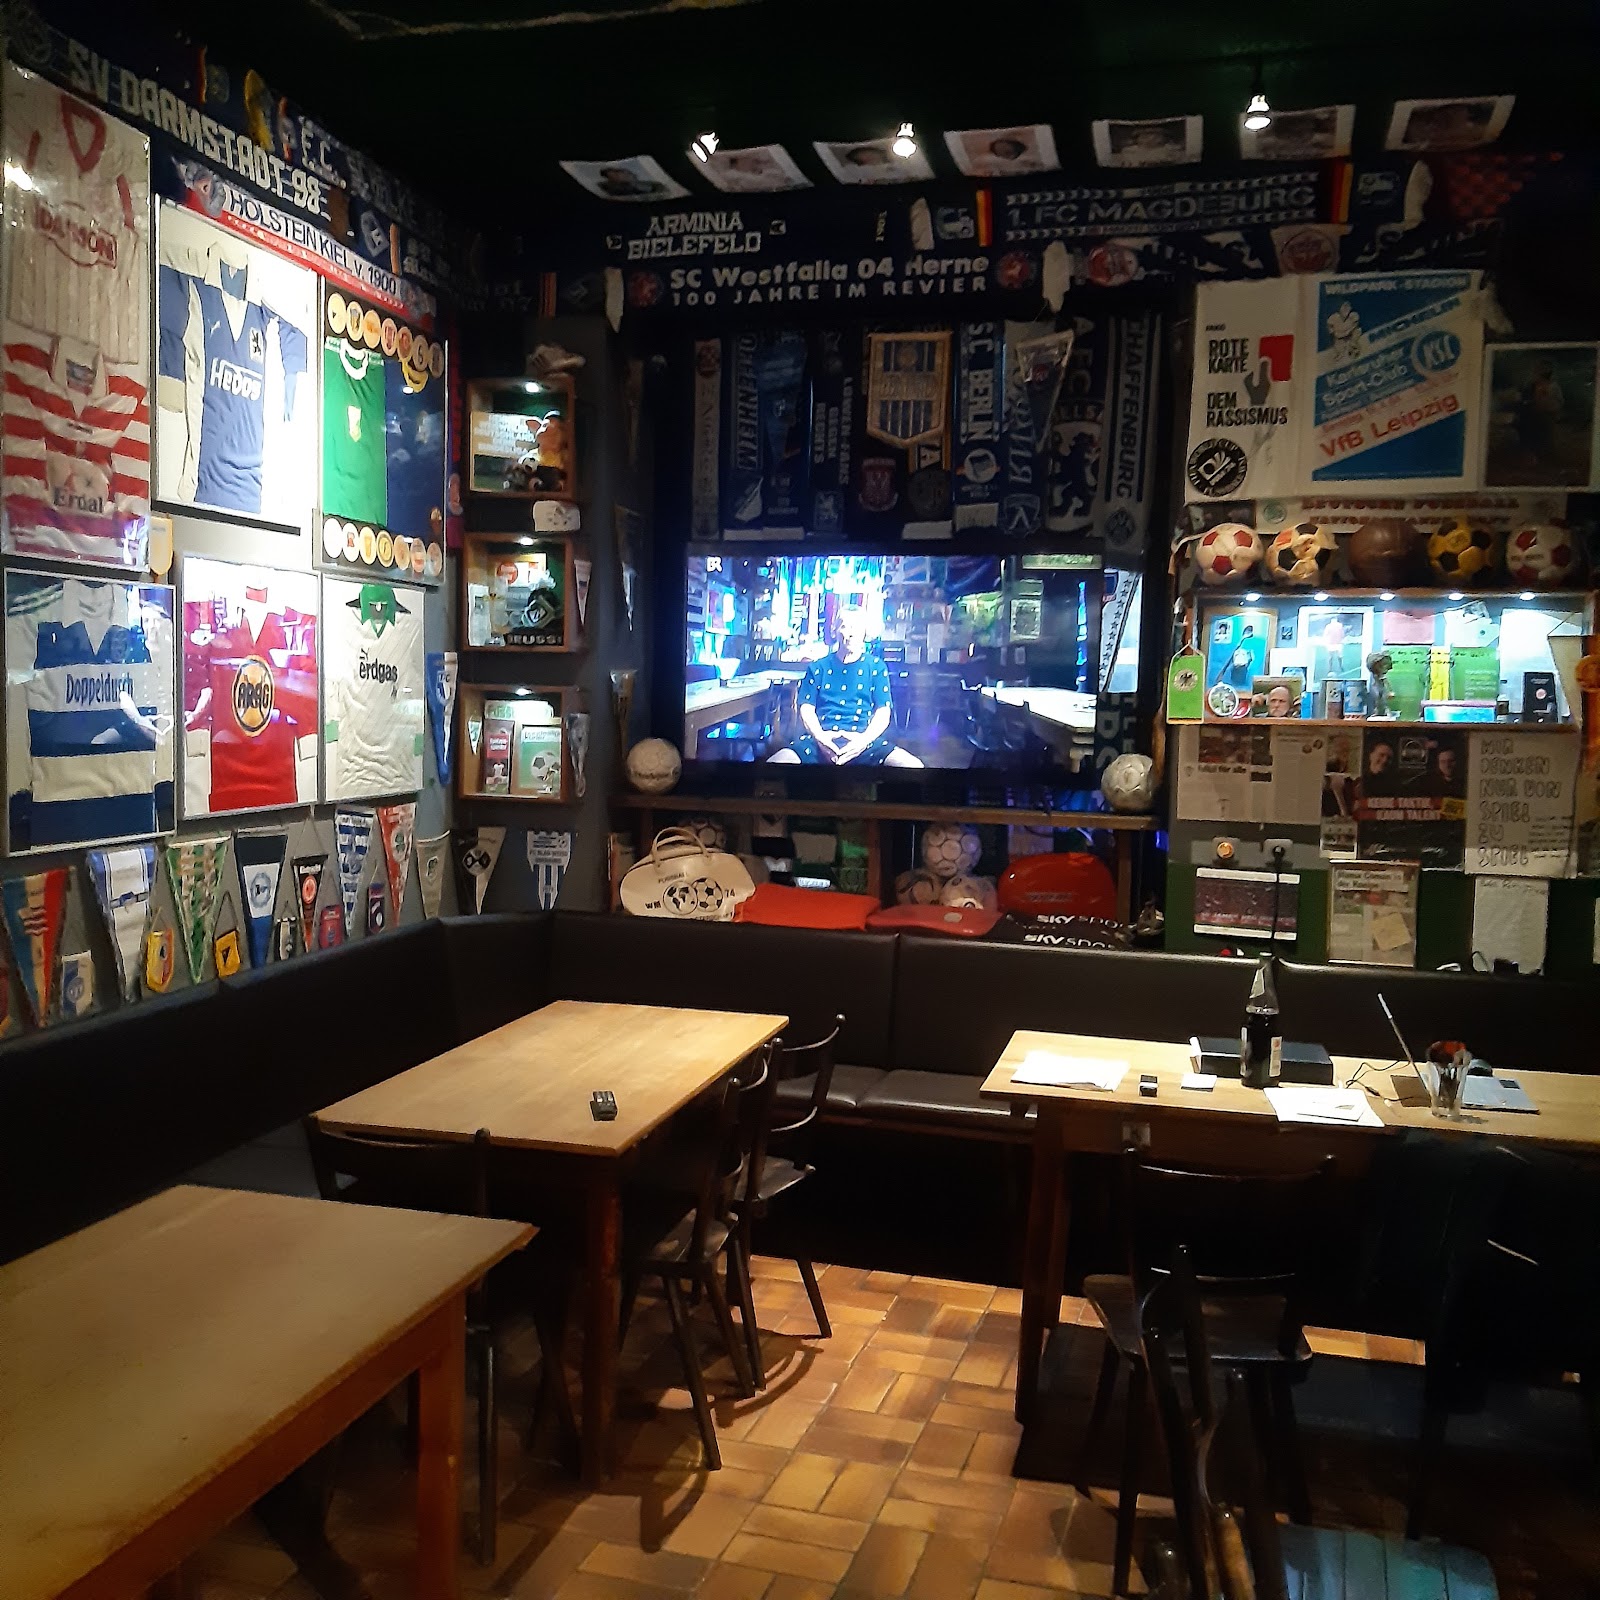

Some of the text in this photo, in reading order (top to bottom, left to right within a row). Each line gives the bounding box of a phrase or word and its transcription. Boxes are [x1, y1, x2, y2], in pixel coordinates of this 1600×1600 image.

[67, 38, 323, 214] SV DARMSTADT 98
[1034, 202, 1080, 225] FC
[1087, 186, 1317, 222] MAGDEBURG
[646, 210, 744, 237] ARMINIA
[229, 194, 316, 252] HOLSTEIN
[319, 233, 353, 270] KIEL
[367, 266, 398, 295] 1900
[627, 232, 762, 260] BIELEFELD
[669, 255, 990, 290] SC Westfalia 04 Herne
[672, 276, 987, 307] 100 JAHRE IM REVIER
[1208, 338, 1249, 358] ROTE
[1208, 357, 1248, 374] KARTE
[967, 321, 994, 442] SC BERLIN
[1207, 391, 1237, 410] DEM
[1206, 406, 1289, 428] RASSISMUS
[1319, 429, 1364, 458] VfB
[1370, 393, 1460, 439] Leipzig
[359, 657, 398, 684] erdgas
[237, 682, 270, 709] ARAG
[644, 888, 735, 910] WM 74
